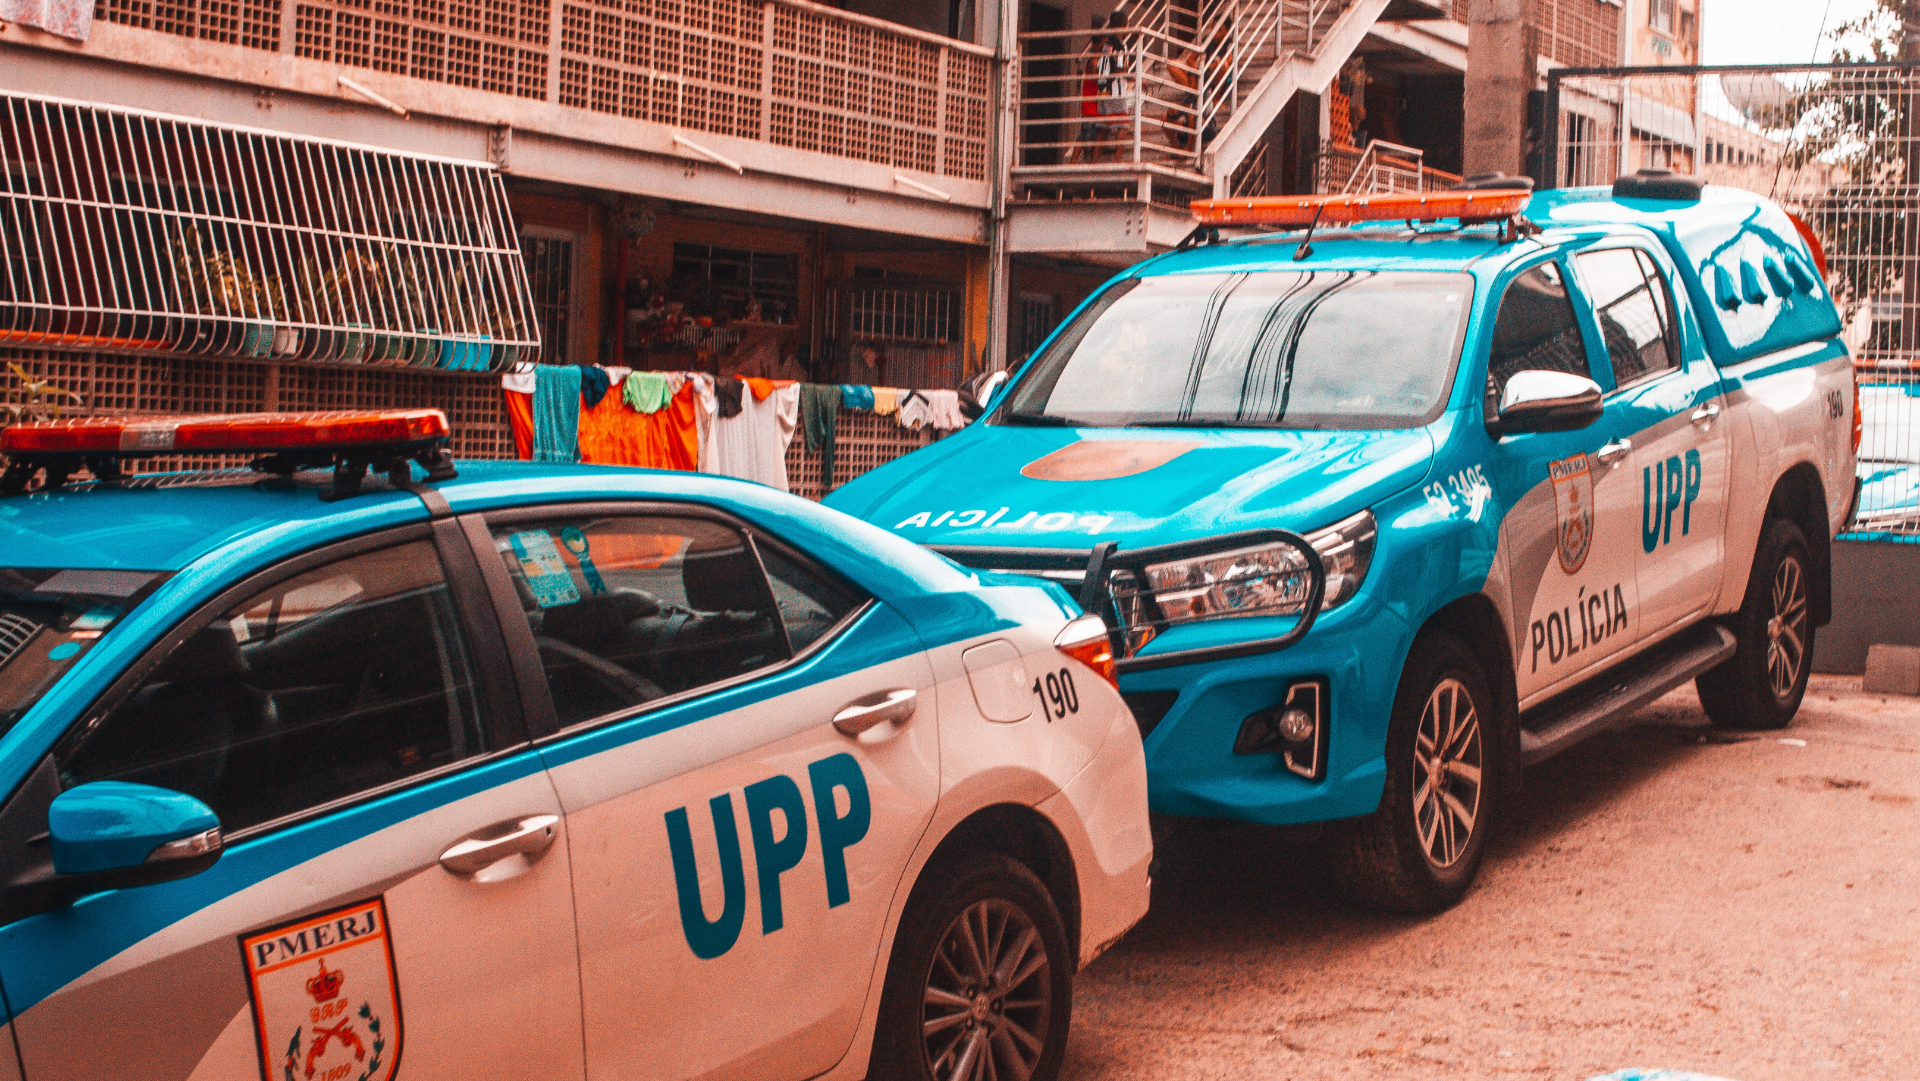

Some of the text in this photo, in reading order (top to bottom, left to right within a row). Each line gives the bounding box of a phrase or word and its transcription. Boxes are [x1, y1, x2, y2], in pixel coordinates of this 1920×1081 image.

[1827, 389, 1843, 419] 190
[1642, 448, 1701, 554] UPP
[1531, 583, 1627, 674] POLÍCIA
[1033, 667, 1079, 723] 190
[664, 752, 871, 960] UPP
[256, 909, 376, 967] PMERJ
